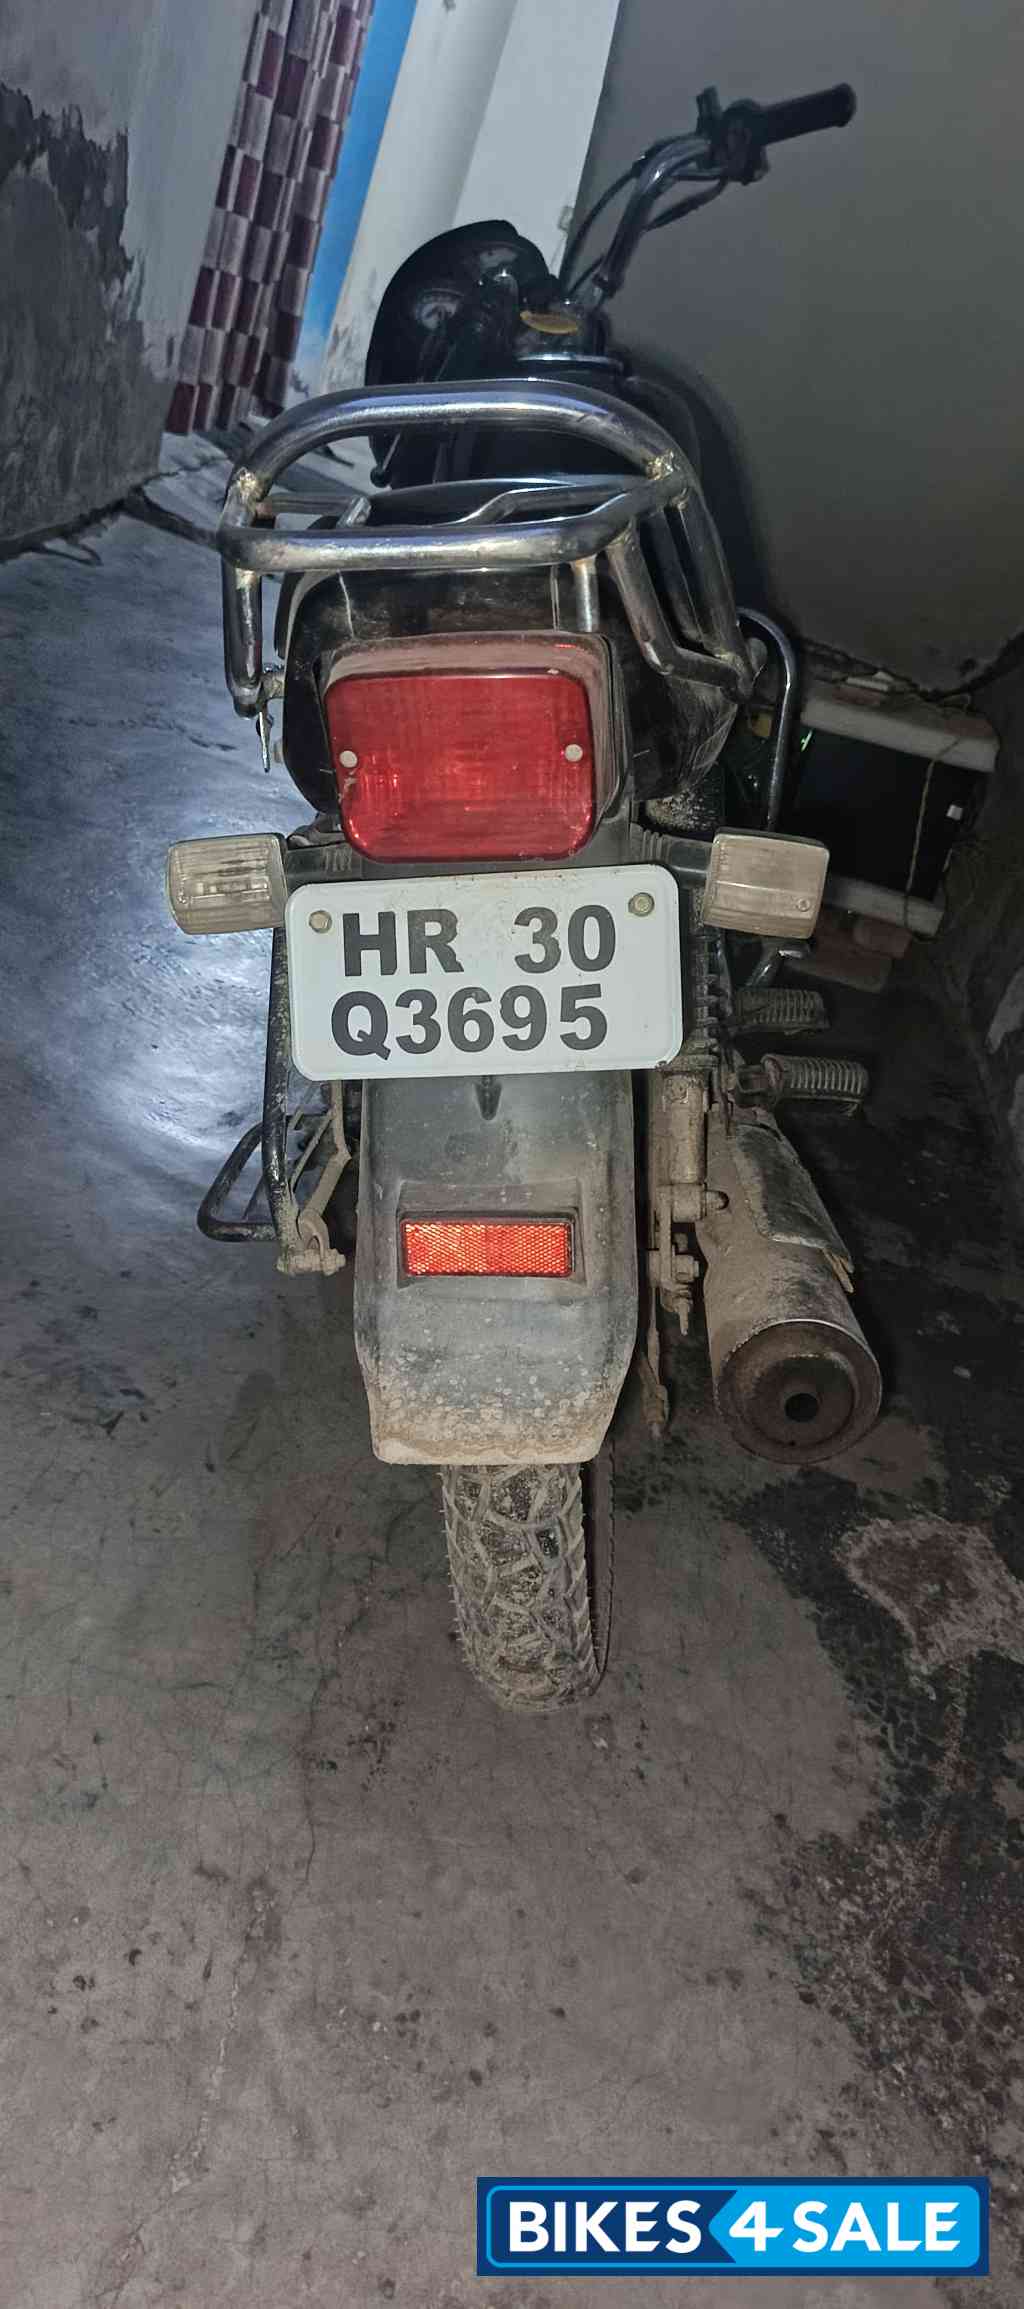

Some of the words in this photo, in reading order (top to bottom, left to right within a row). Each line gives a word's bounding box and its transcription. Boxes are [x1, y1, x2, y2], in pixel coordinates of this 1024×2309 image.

[342, 908, 465, 977] HR
[513, 904, 616, 974] 30
[331, 983, 608, 1060] Q3695
